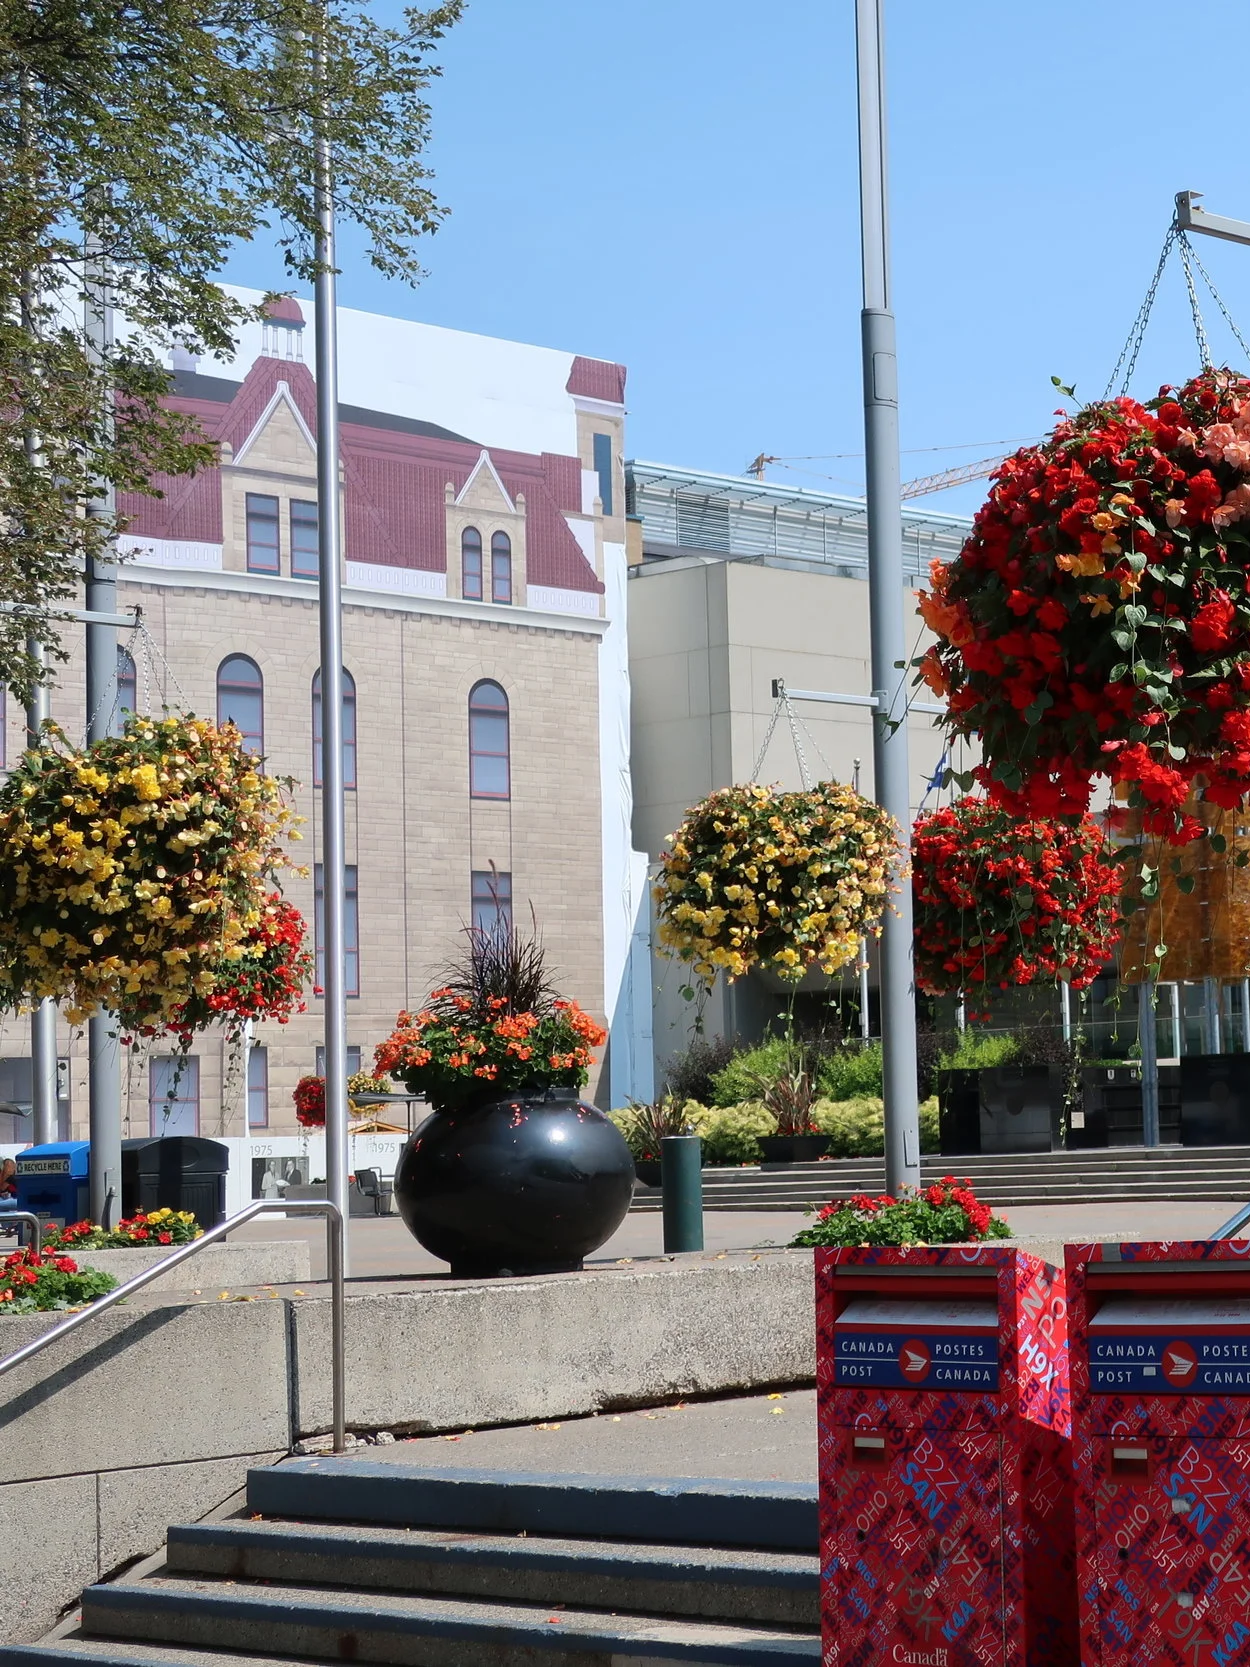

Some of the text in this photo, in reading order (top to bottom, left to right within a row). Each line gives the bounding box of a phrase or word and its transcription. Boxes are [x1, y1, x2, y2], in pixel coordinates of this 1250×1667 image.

[250, 1145, 273, 1156] 1975
[373, 1143, 395, 1153] 1975
[24, 1160, 62, 1172] RECYCLE HERE
[841, 1341, 894, 1353] CANADA
[935, 1344, 984, 1356] POSTES
[1097, 1345, 1155, 1357] CANADA
[841, 1365, 873, 1377] POST
[936, 1368, 991, 1381] CANADA
[1019, 1334, 1059, 1392] H9X
[1098, 1371, 1132, 1383] POST
[959, 1437, 981, 1461] J5T
[913, 1437, 960, 1500] B2Z
[1177, 1446, 1231, 1513] B2Z
[900, 1461, 945, 1520] S4N
[890, 1533, 911, 1556] J5T
[1153, 1549, 1177, 1574] J5T
[941, 1600, 975, 1643] K4A
[1107, 1609, 1133, 1643] S4N
[892, 1643, 948, 1667] Canada
